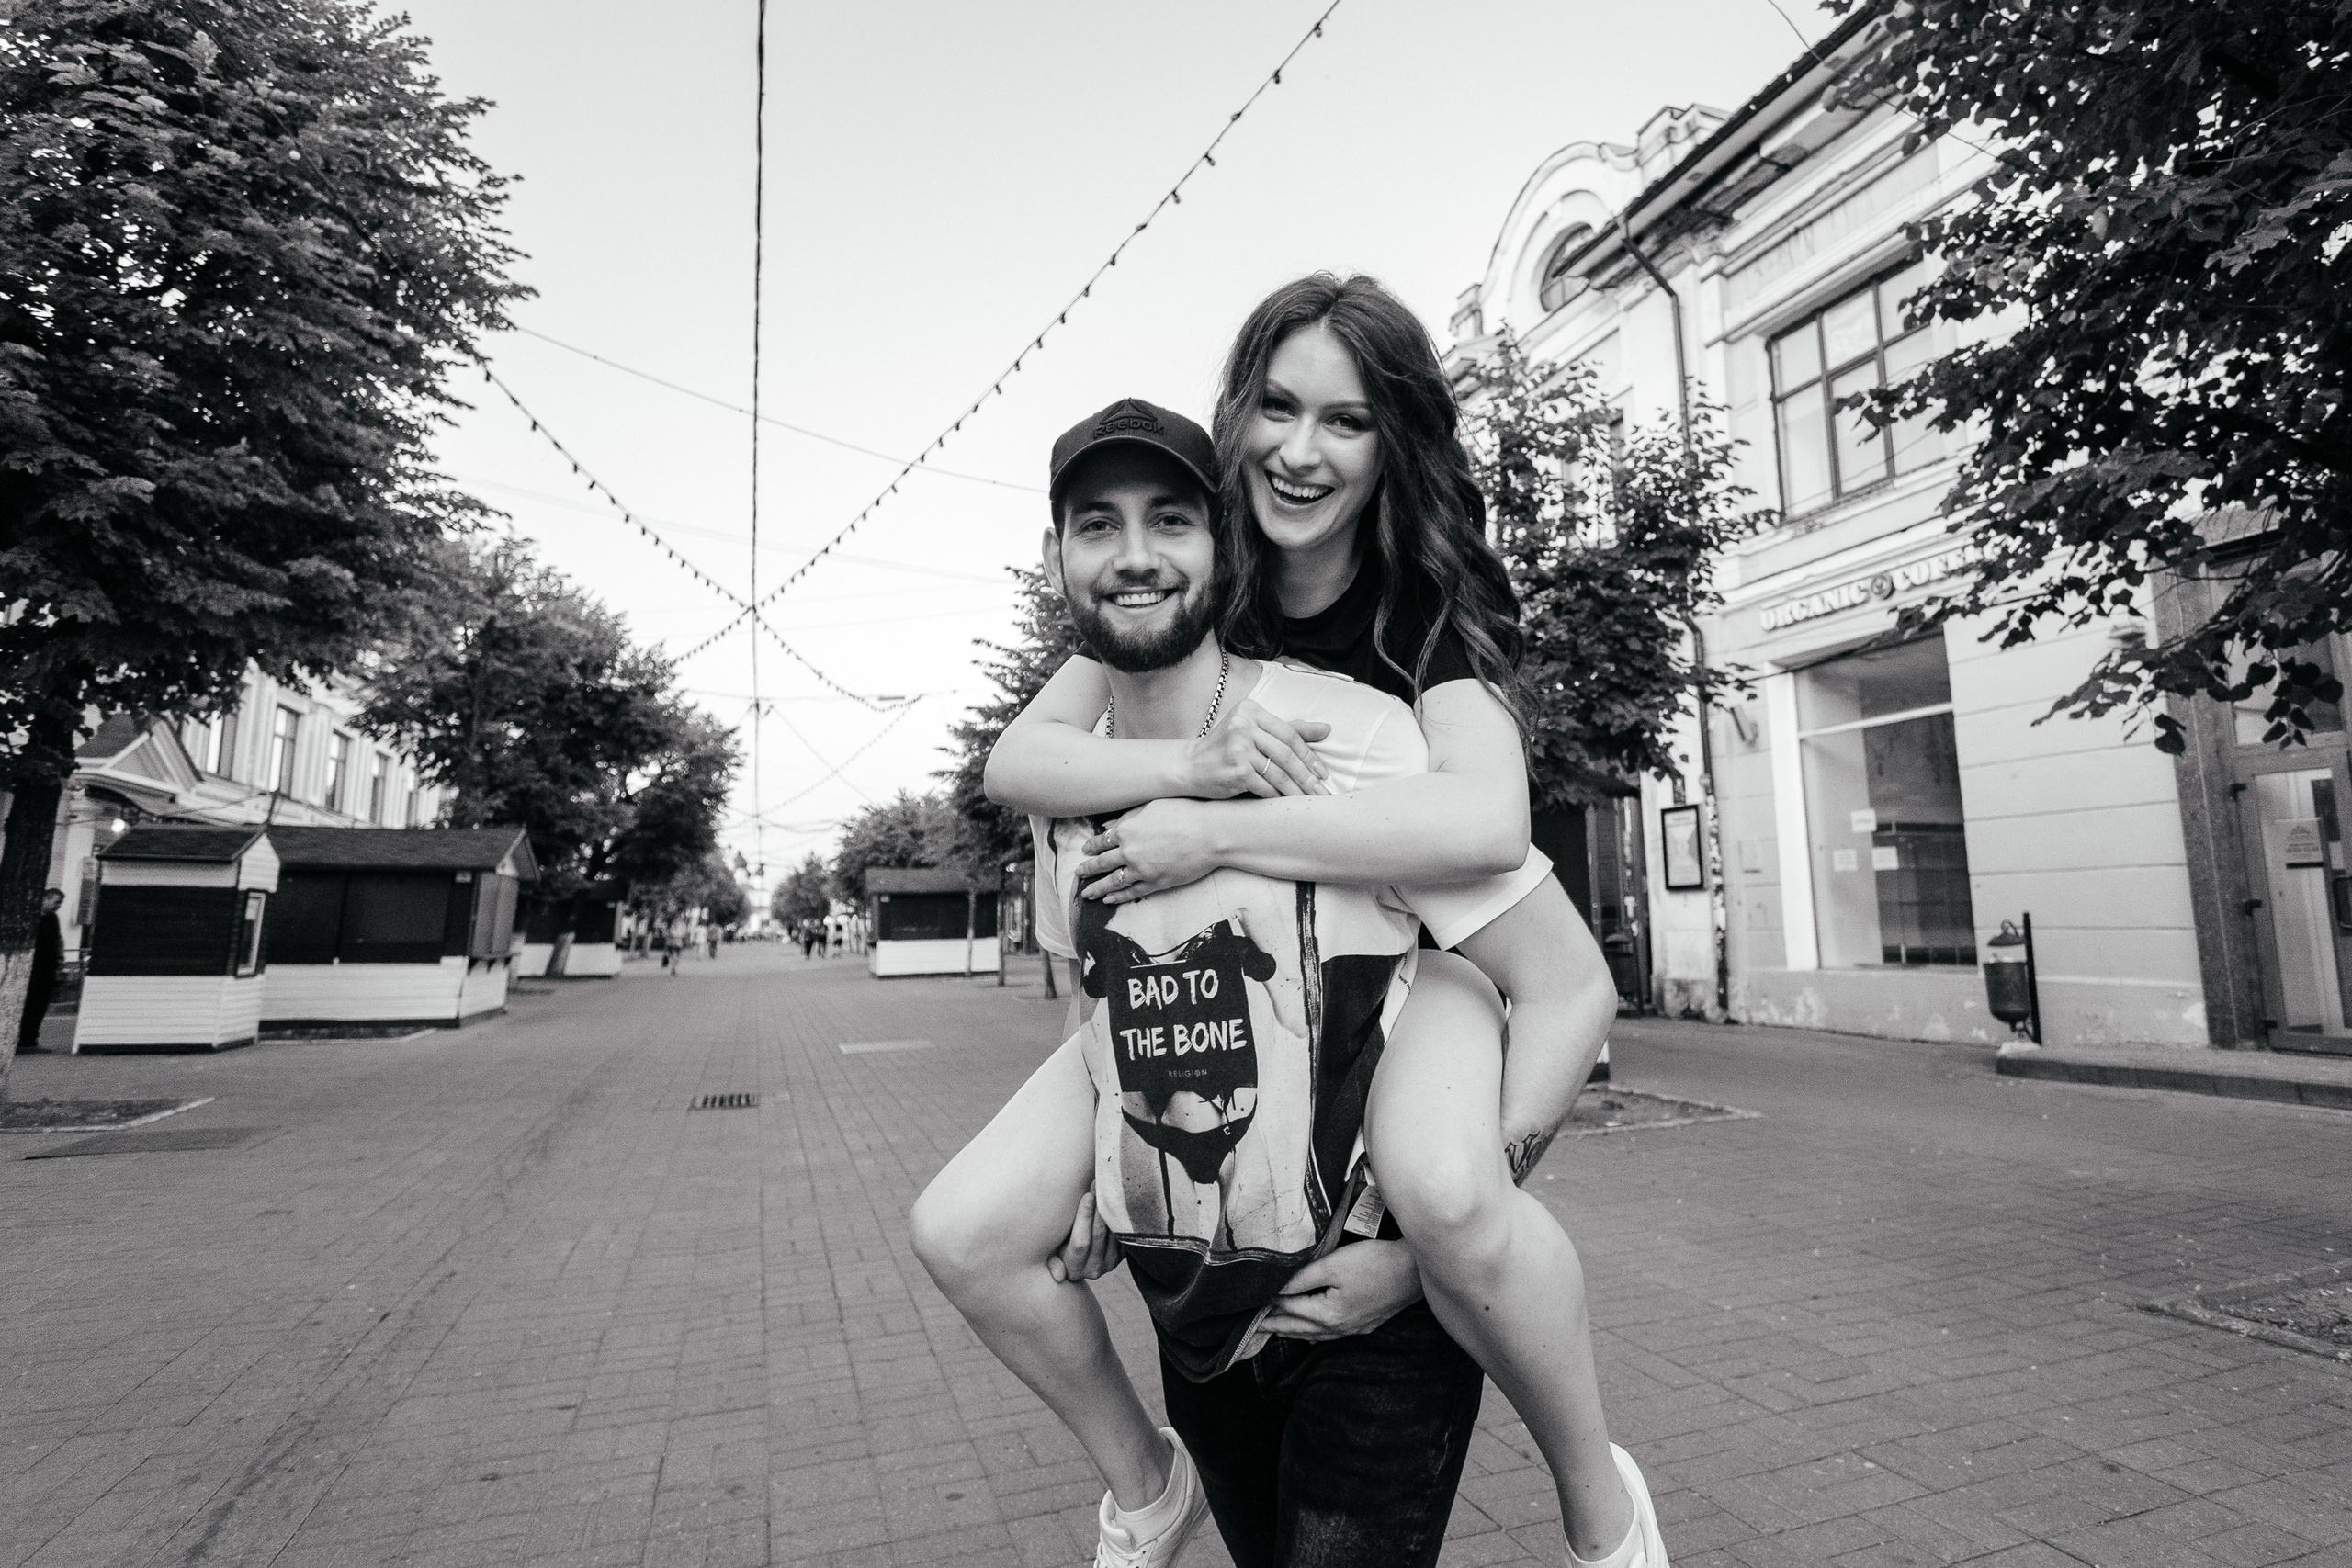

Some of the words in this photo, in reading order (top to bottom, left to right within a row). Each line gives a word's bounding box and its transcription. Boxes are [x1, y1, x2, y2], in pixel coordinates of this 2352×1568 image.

[1093, 418, 1165, 439] Reebok
[1760, 580, 1870, 632] ORGANIC
[1127, 975, 1179, 1010] BAD
[1182, 968, 1219, 1005] TO
[1119, 1026, 1167, 1061] THE
[1173, 1018, 1247, 1056] BONE
[1168, 1068, 1207, 1077] RELIGION
